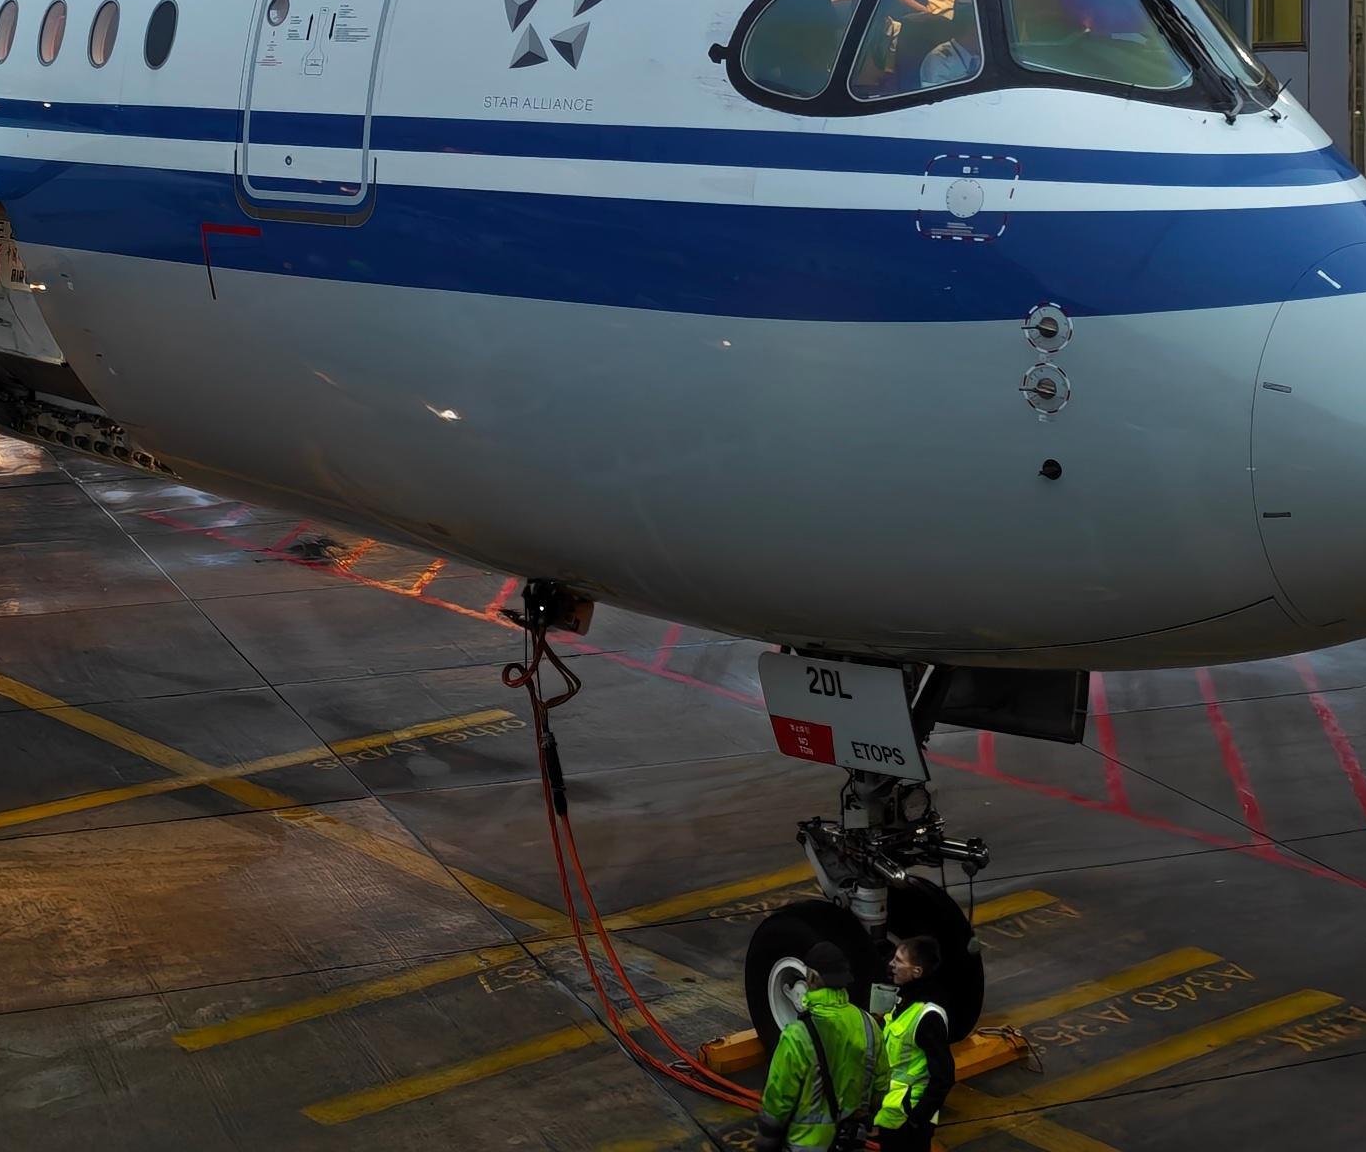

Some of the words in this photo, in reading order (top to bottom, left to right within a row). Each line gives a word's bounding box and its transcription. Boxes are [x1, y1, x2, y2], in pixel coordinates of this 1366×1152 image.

[483, 95, 519, 109] STAR
[522, 97, 594, 112] ALLIANCE
[806, 666, 853, 699] 2DL
[851, 740, 905, 766] ETOPS
